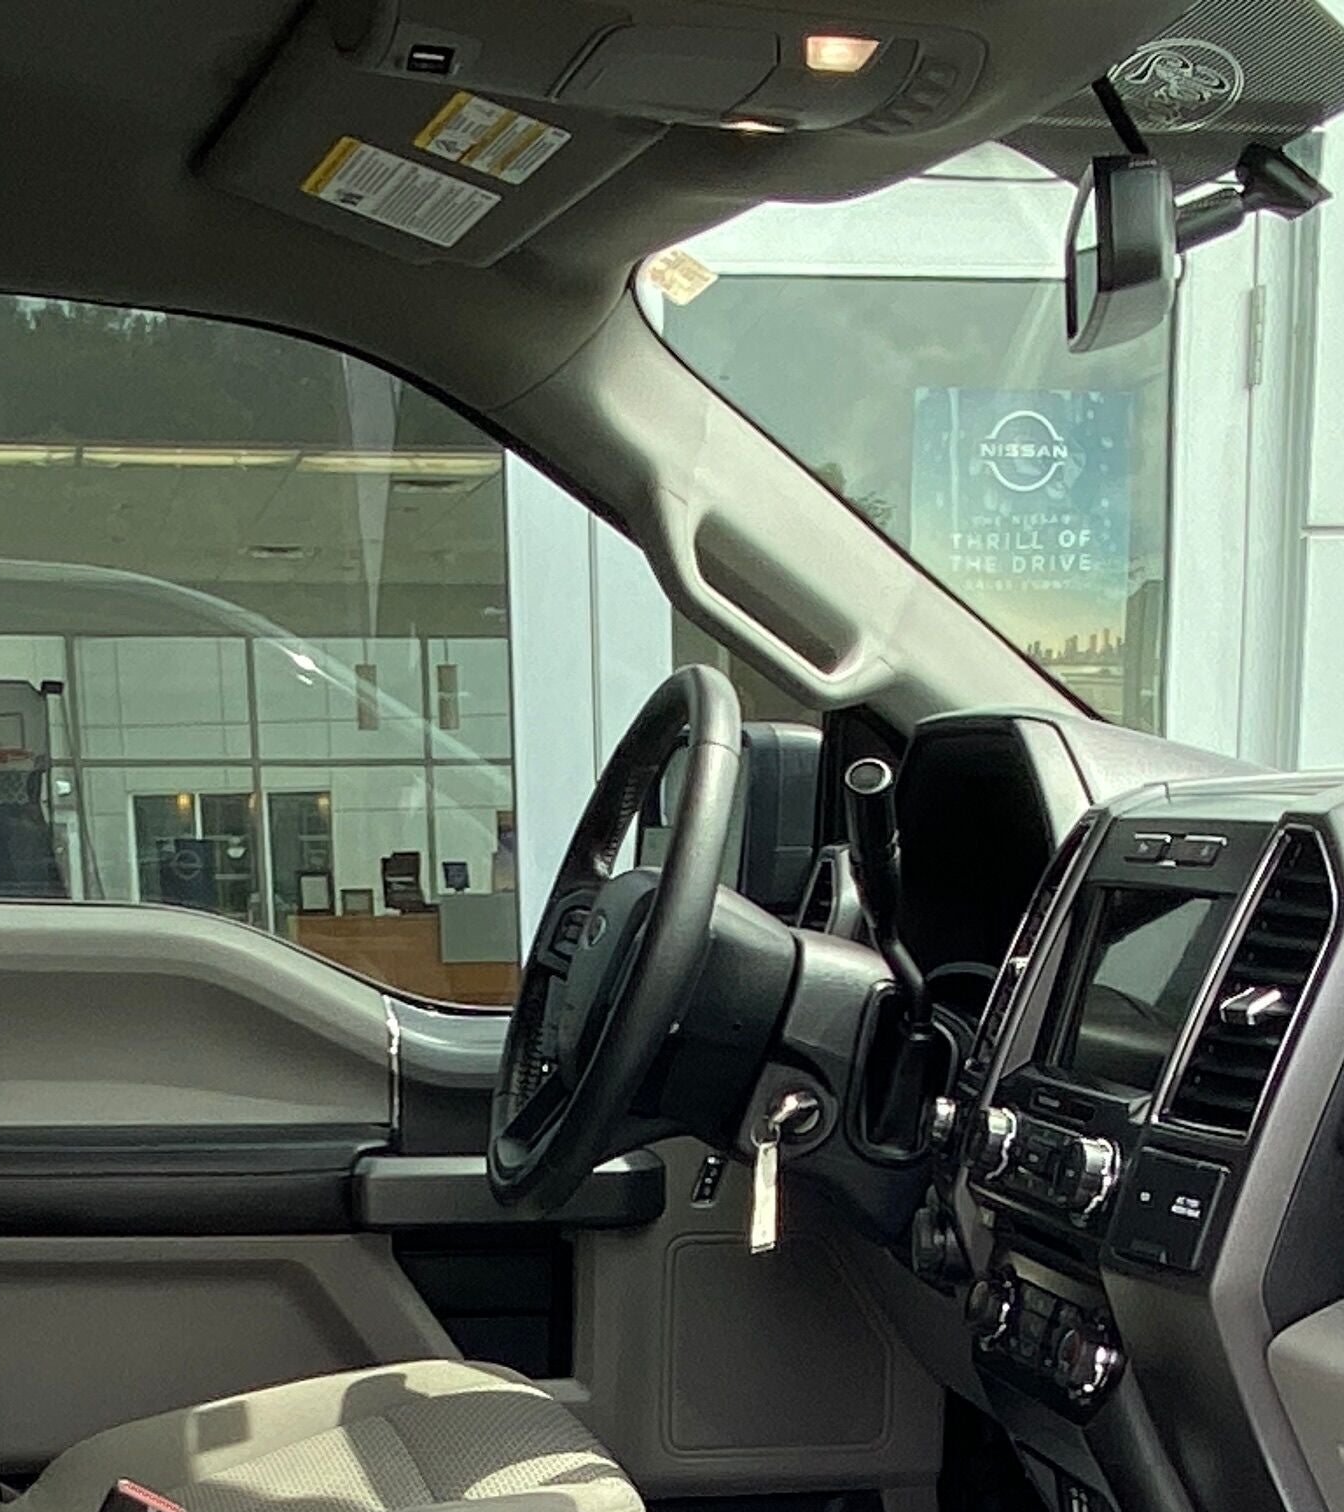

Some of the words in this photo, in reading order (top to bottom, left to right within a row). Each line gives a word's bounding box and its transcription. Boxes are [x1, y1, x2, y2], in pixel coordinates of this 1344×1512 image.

[980, 443, 1068, 458] NISSAN
[951, 532, 1044, 550] THRILL
[1058, 529, 1091, 548] OF
[949, 555, 998, 573] THE
[1012, 553, 1092, 573] DRIVE
